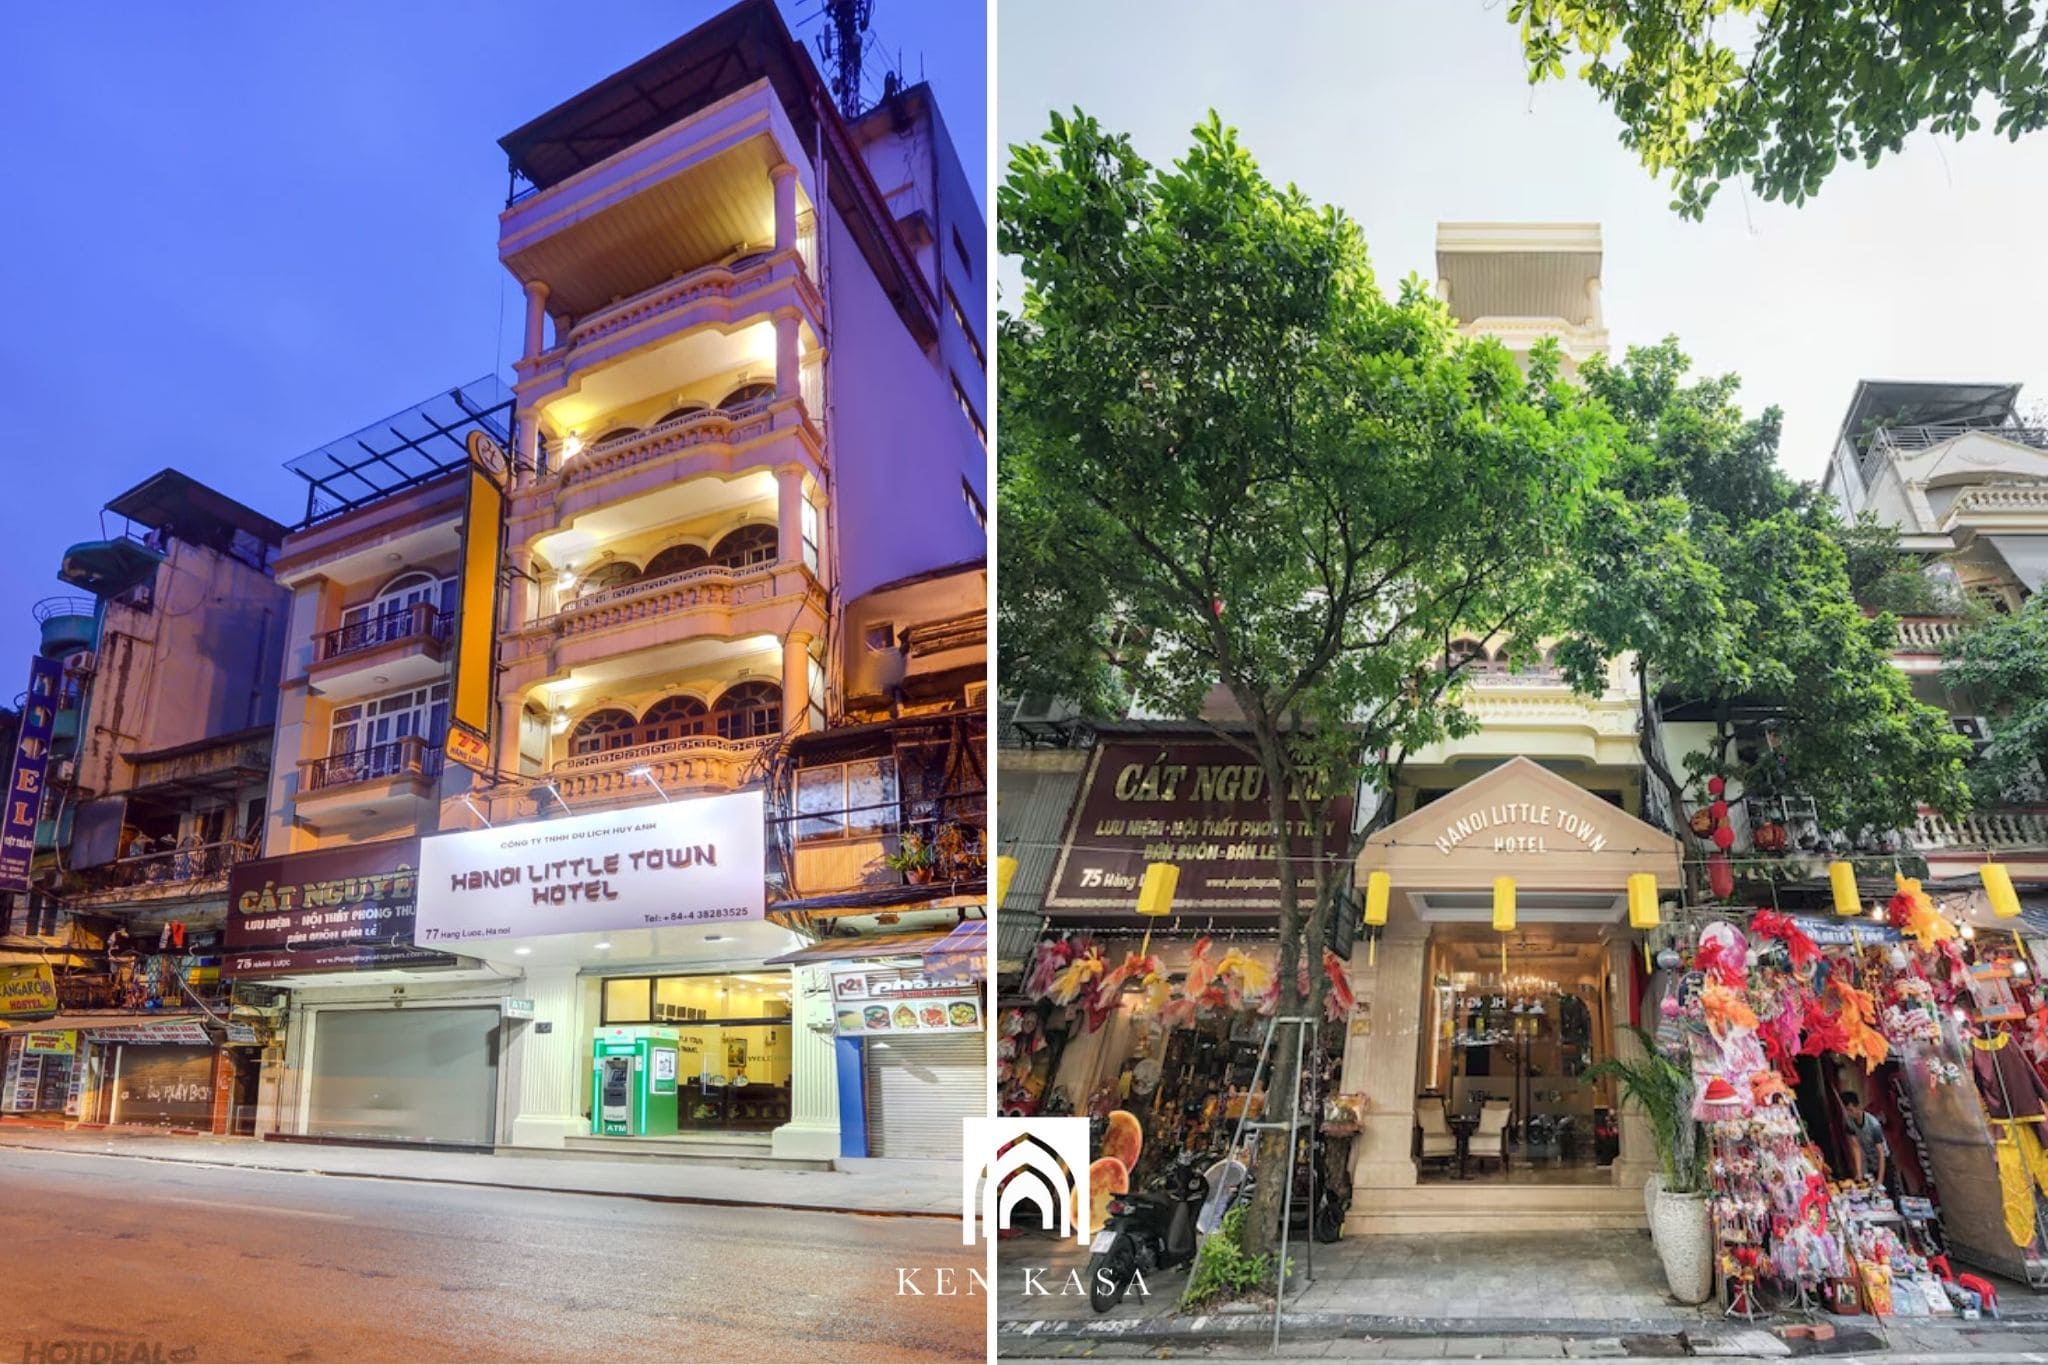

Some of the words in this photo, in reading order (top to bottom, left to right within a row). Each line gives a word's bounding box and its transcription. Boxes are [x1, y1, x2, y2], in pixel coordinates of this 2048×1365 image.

[458, 732, 483, 754] 77
[1115, 752, 1187, 801] CÁT
[500, 838, 528, 848] CÔNG
[545, 832, 569, 843] TNHH
[572, 832, 584, 840] DU
[612, 824, 632, 834] HUY
[634, 822, 656, 832] ANH
[1434, 808, 1487, 854] HANOI
[1491, 803, 1552, 826] LITTLE
[1556, 808, 1608, 852] TOWN
[1494, 836, 1548, 852] HOTEL
[528, 853, 619, 882] LITTLE
[629, 844, 717, 870] TOWN
[239, 880, 296, 914] CÁT
[302, 864, 418, 908] NGUYÊ
[1080, 869, 1102, 887] 75
[1103, 871, 1136, 891] Hàng
[533, 880, 618, 905] HOTEL
[352, 908, 392, 920] PHONG
[697, 907, 748, 920] 38283525
[426, 928, 439, 940] 77
[236, 958, 252, 970] 75
[512, 1000, 530, 1010] ATM
[606, 1124, 626, 1132] ATM
